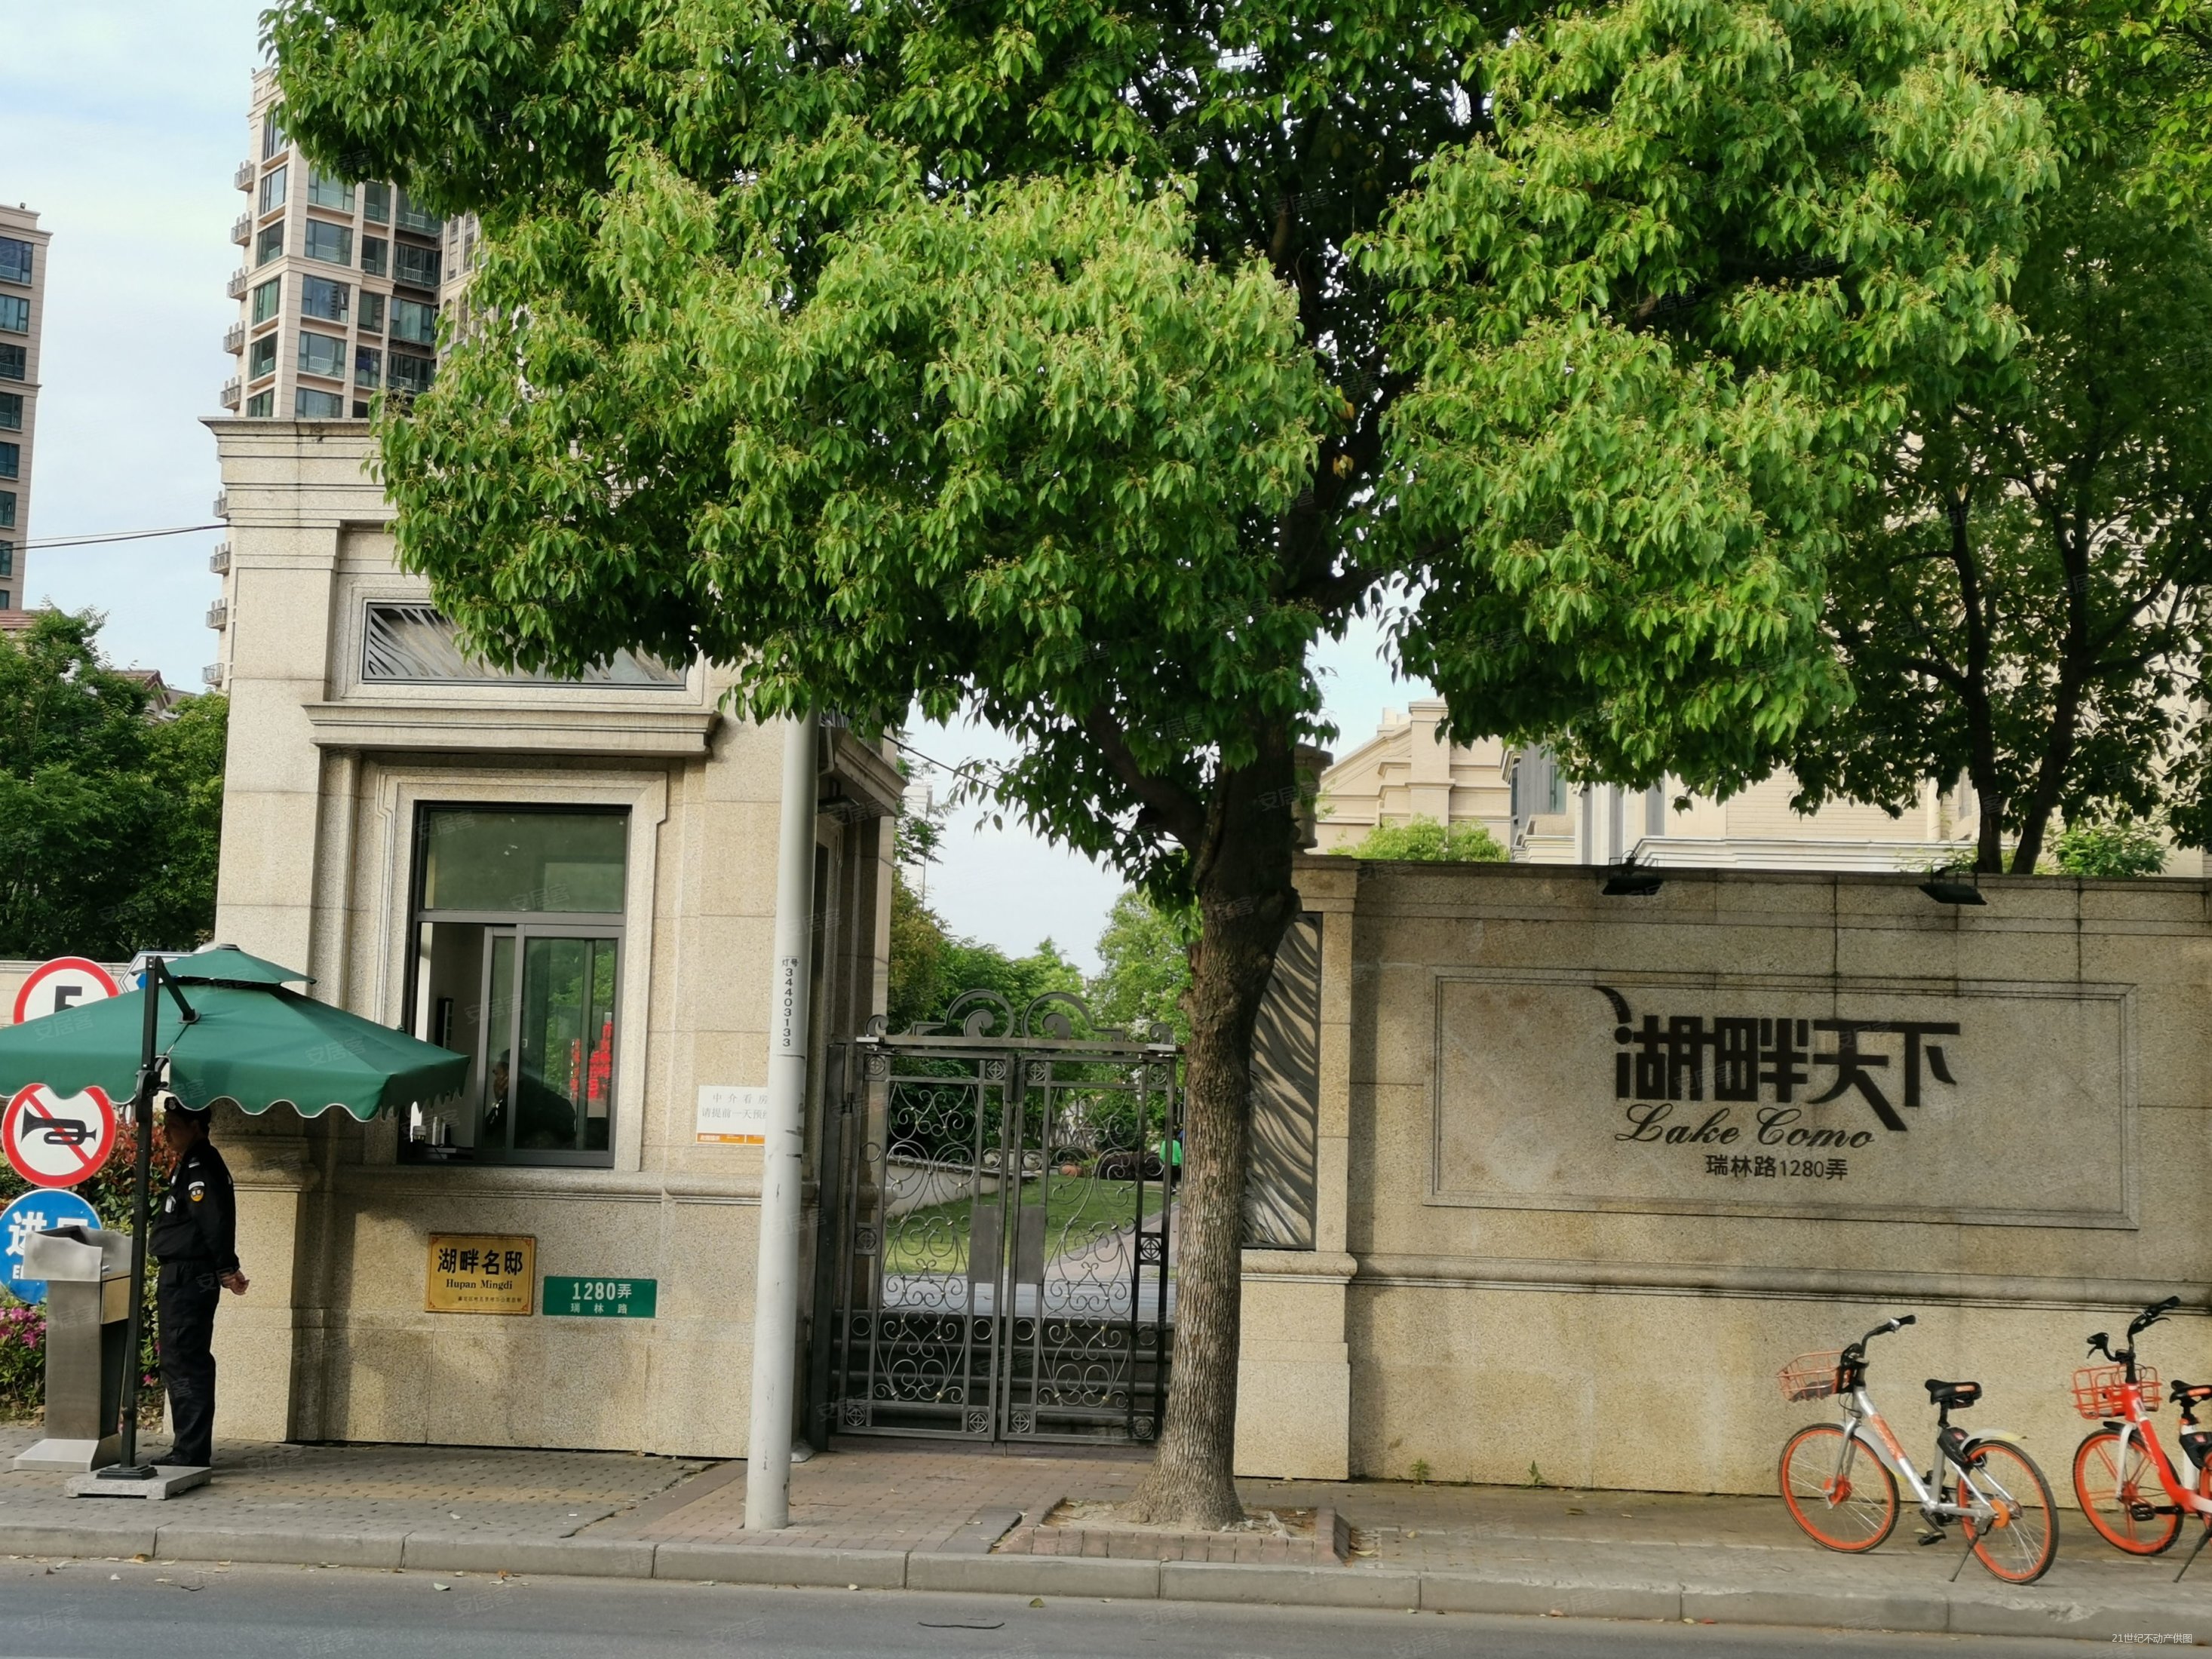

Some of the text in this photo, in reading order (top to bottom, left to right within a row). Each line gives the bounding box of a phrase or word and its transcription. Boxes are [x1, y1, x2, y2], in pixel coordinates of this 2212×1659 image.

[782, 958, 799, 967] 灯号
[783, 967, 793, 1047] 34403133
[1593, 986, 1960, 1132] 湖畔天下
[1615, 1103, 1876, 1148] Lake Como
[1706, 1155, 1848, 1181] 瑞林路1280弄
[6, 1211, 88, 1256] 进
[437, 1247, 523, 1276] 湖畔名邸
[446, 1279, 513, 1290] Hupan Mingdi
[572, 1281, 632, 1301] 1280弄
[570, 1302, 627, 1314] 瑞林路
